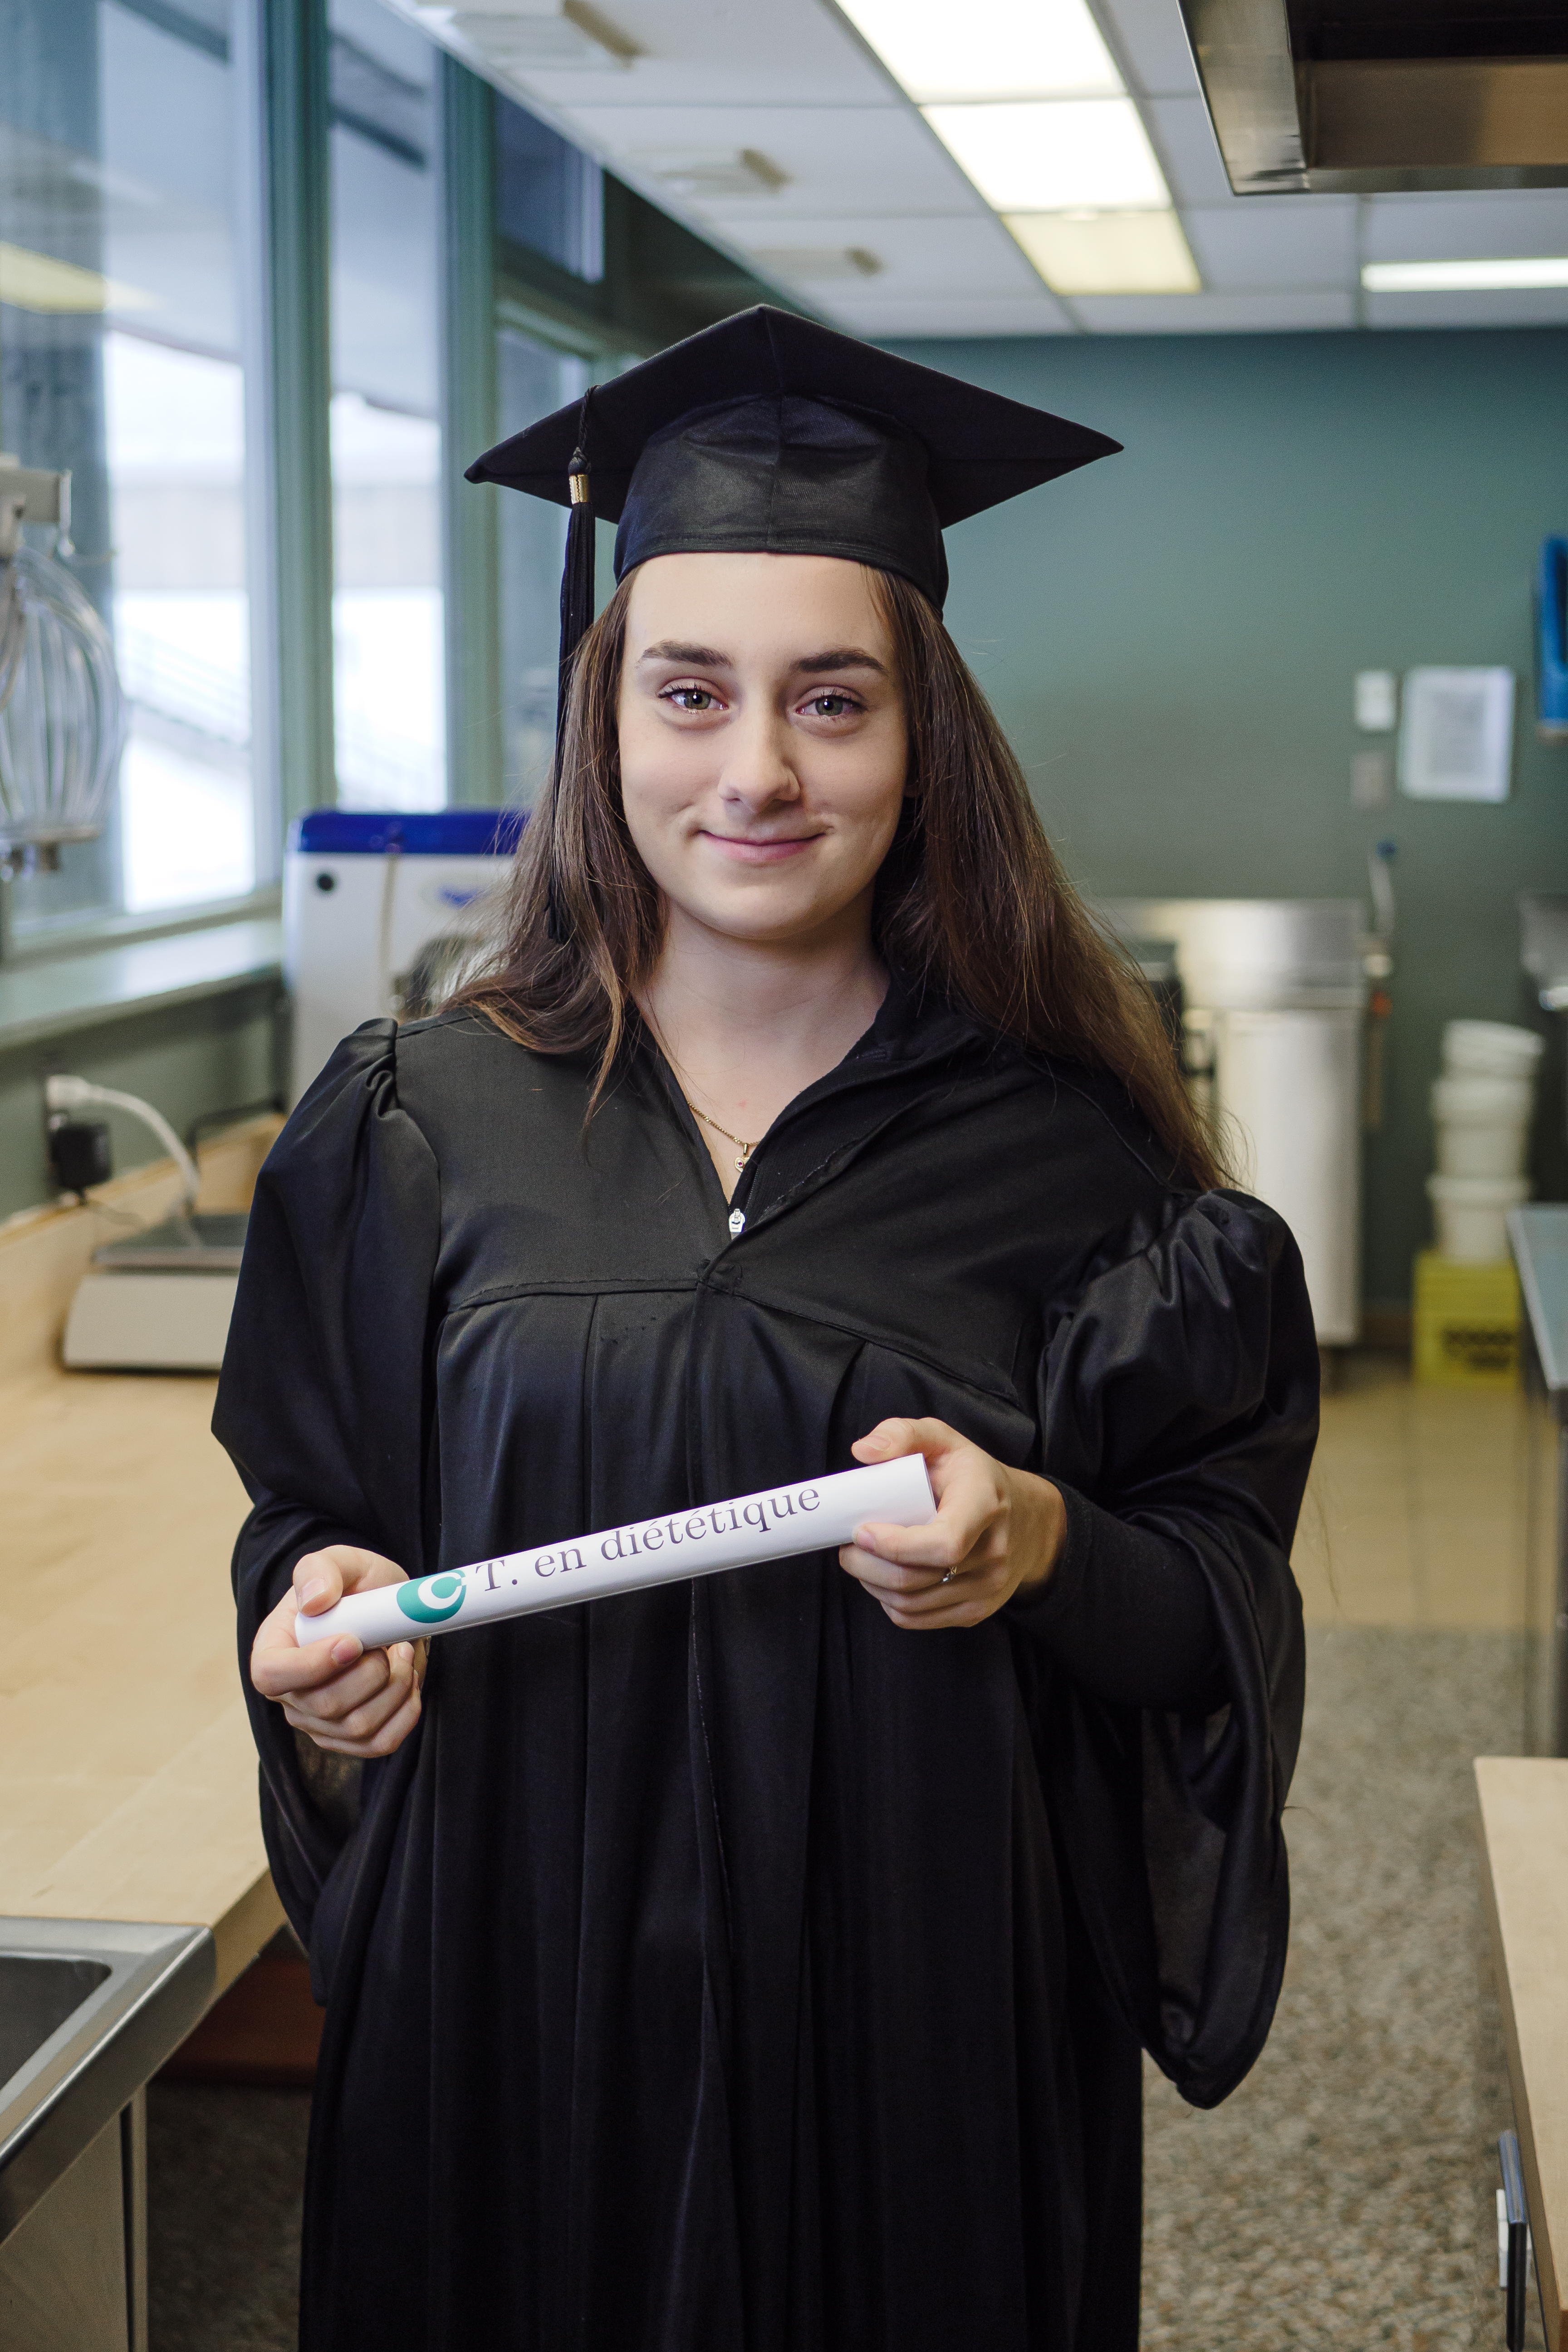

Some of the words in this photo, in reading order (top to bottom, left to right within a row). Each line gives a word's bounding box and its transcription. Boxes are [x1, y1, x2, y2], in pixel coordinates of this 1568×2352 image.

[475, 1559, 518, 1592] T.
[534, 1548, 587, 1577] en
[601, 1488, 820, 1561] diététique
